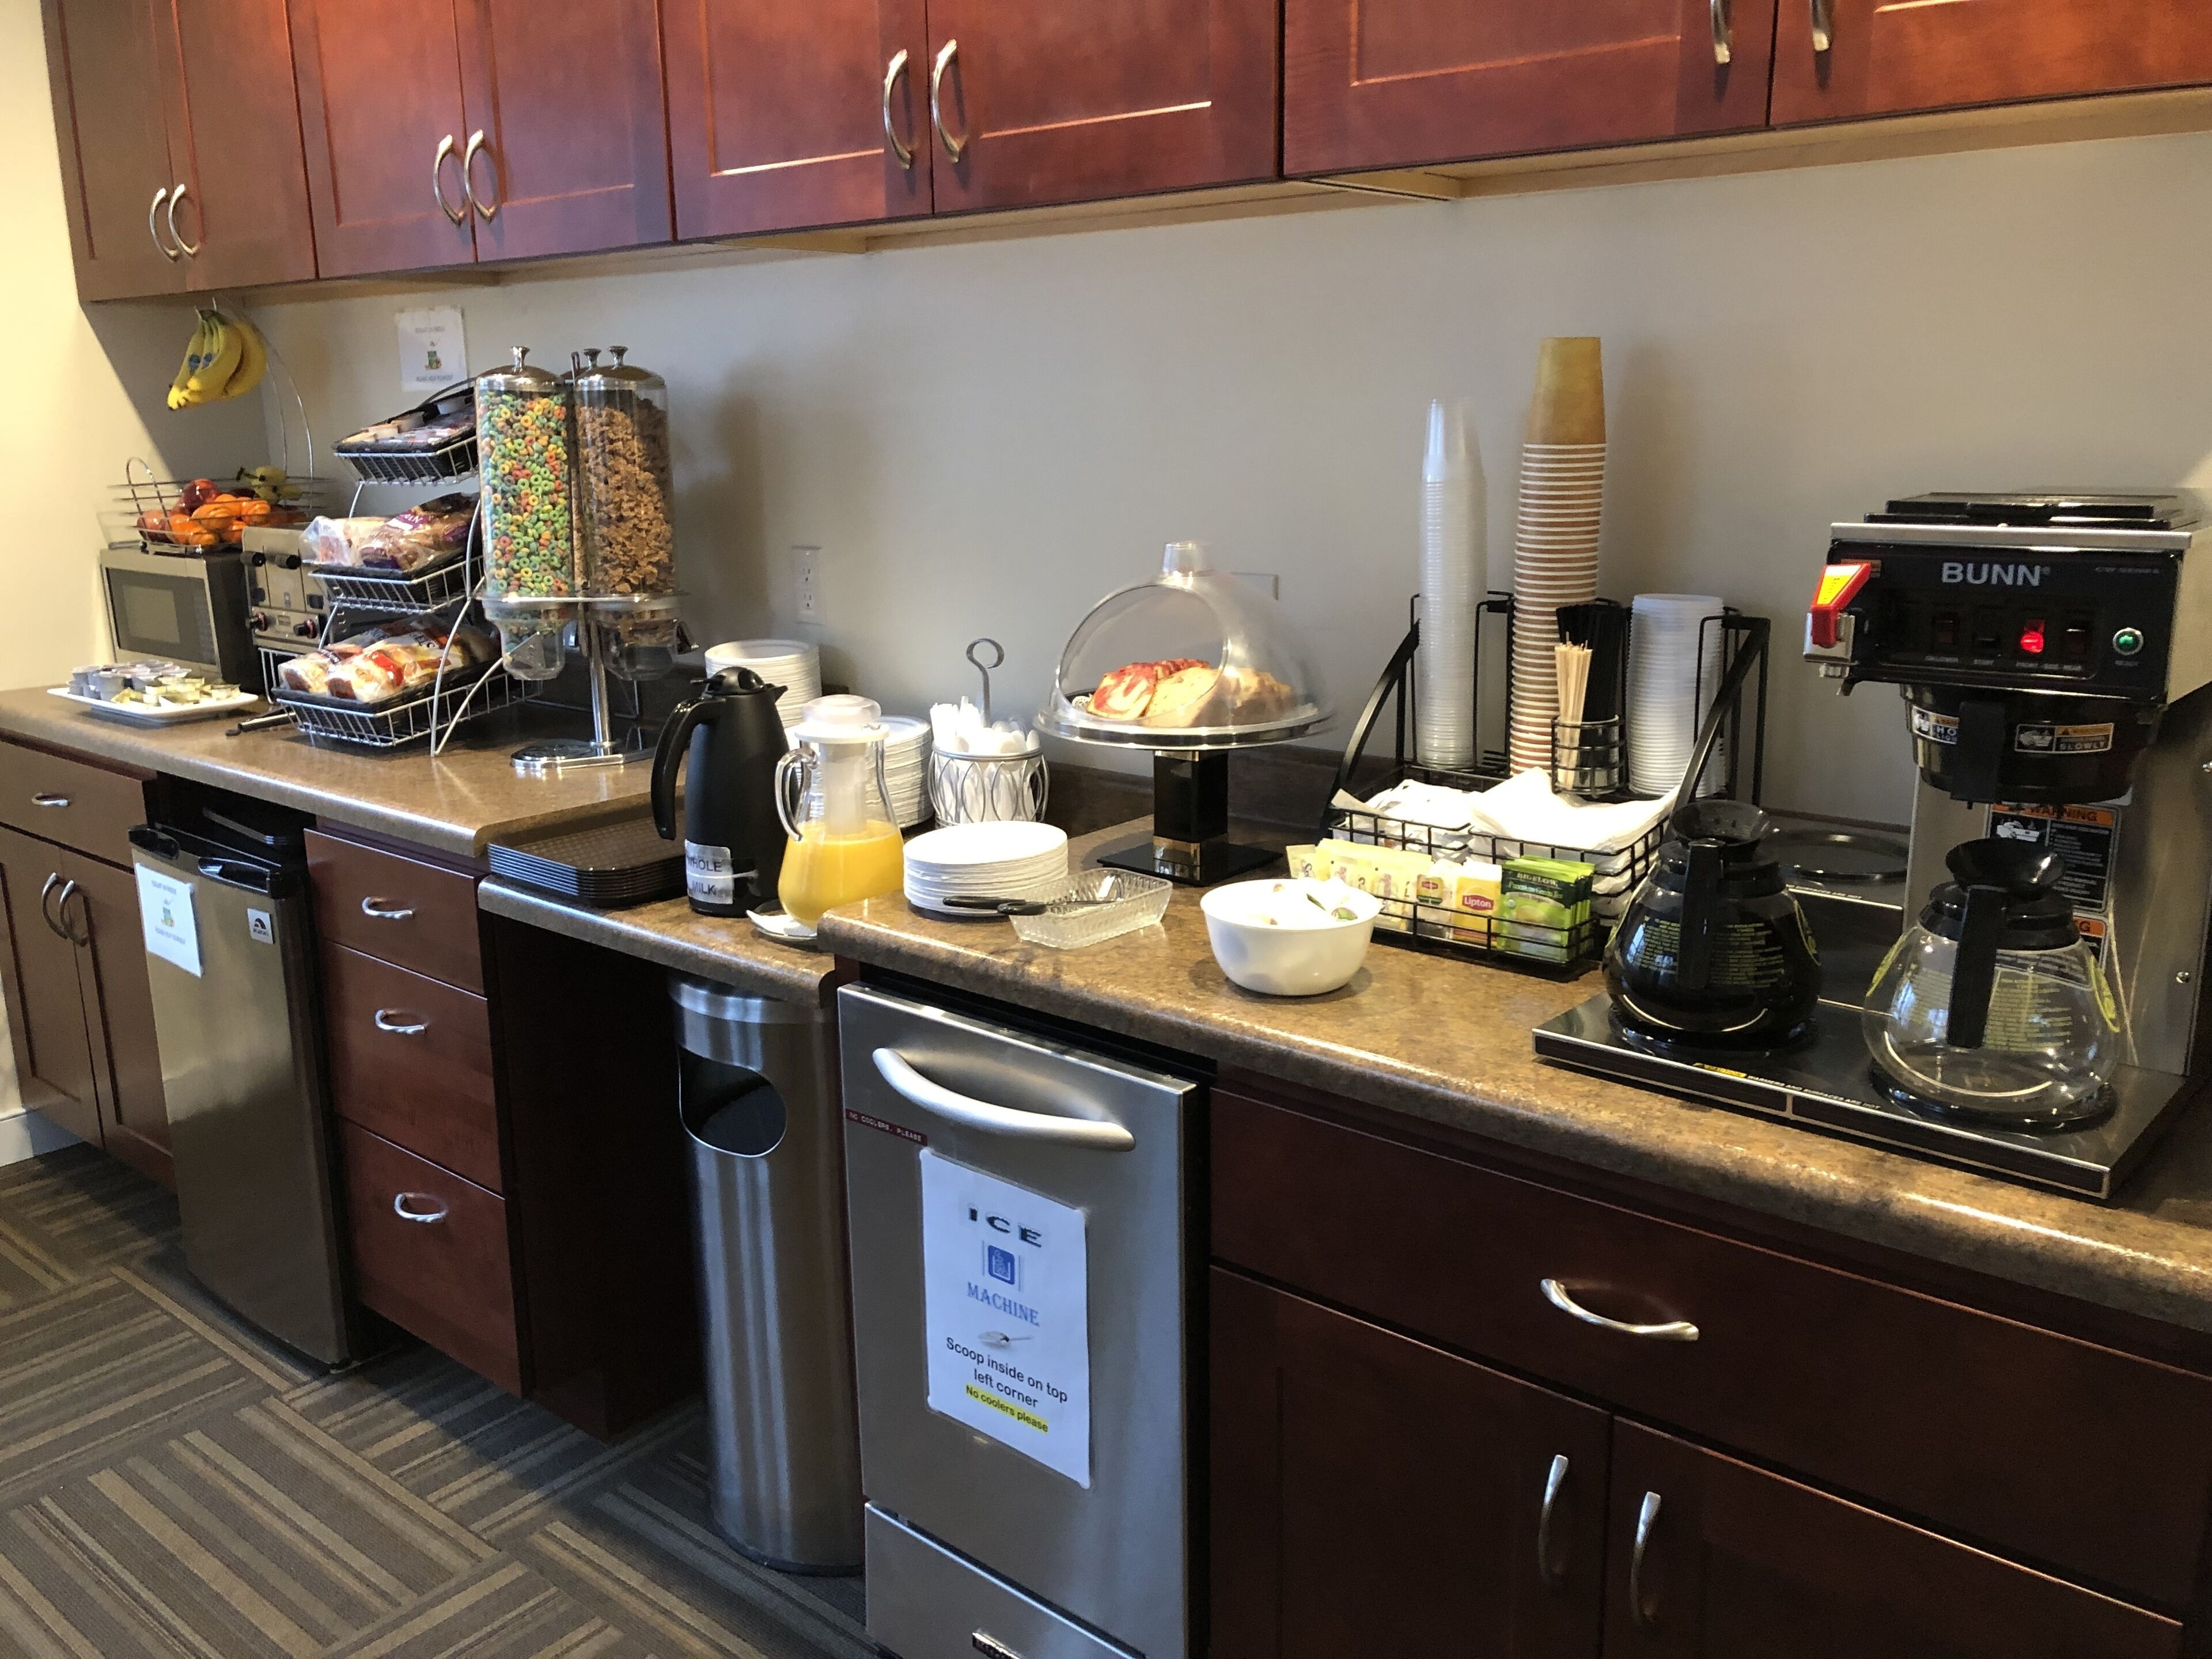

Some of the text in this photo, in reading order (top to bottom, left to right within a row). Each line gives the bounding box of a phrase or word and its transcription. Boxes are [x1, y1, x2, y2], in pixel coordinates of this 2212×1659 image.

[1941, 562, 2042, 586] BUNN
[1937, 725, 1957, 736] HO
[687, 856, 722, 872] WHOLE
[692, 881, 717, 895] MILK
[1464, 896, 1492, 908] Lipton
[897, 1127, 922, 1141] PLEASE
[968, 1206, 1042, 1249] ICE
[967, 1281, 1040, 1327] MACHINE
[946, 1336, 1068, 1403] Scoop inside on top
[974, 1368, 1039, 1408] left corner
[965, 1384, 1048, 1433] No coolers please
